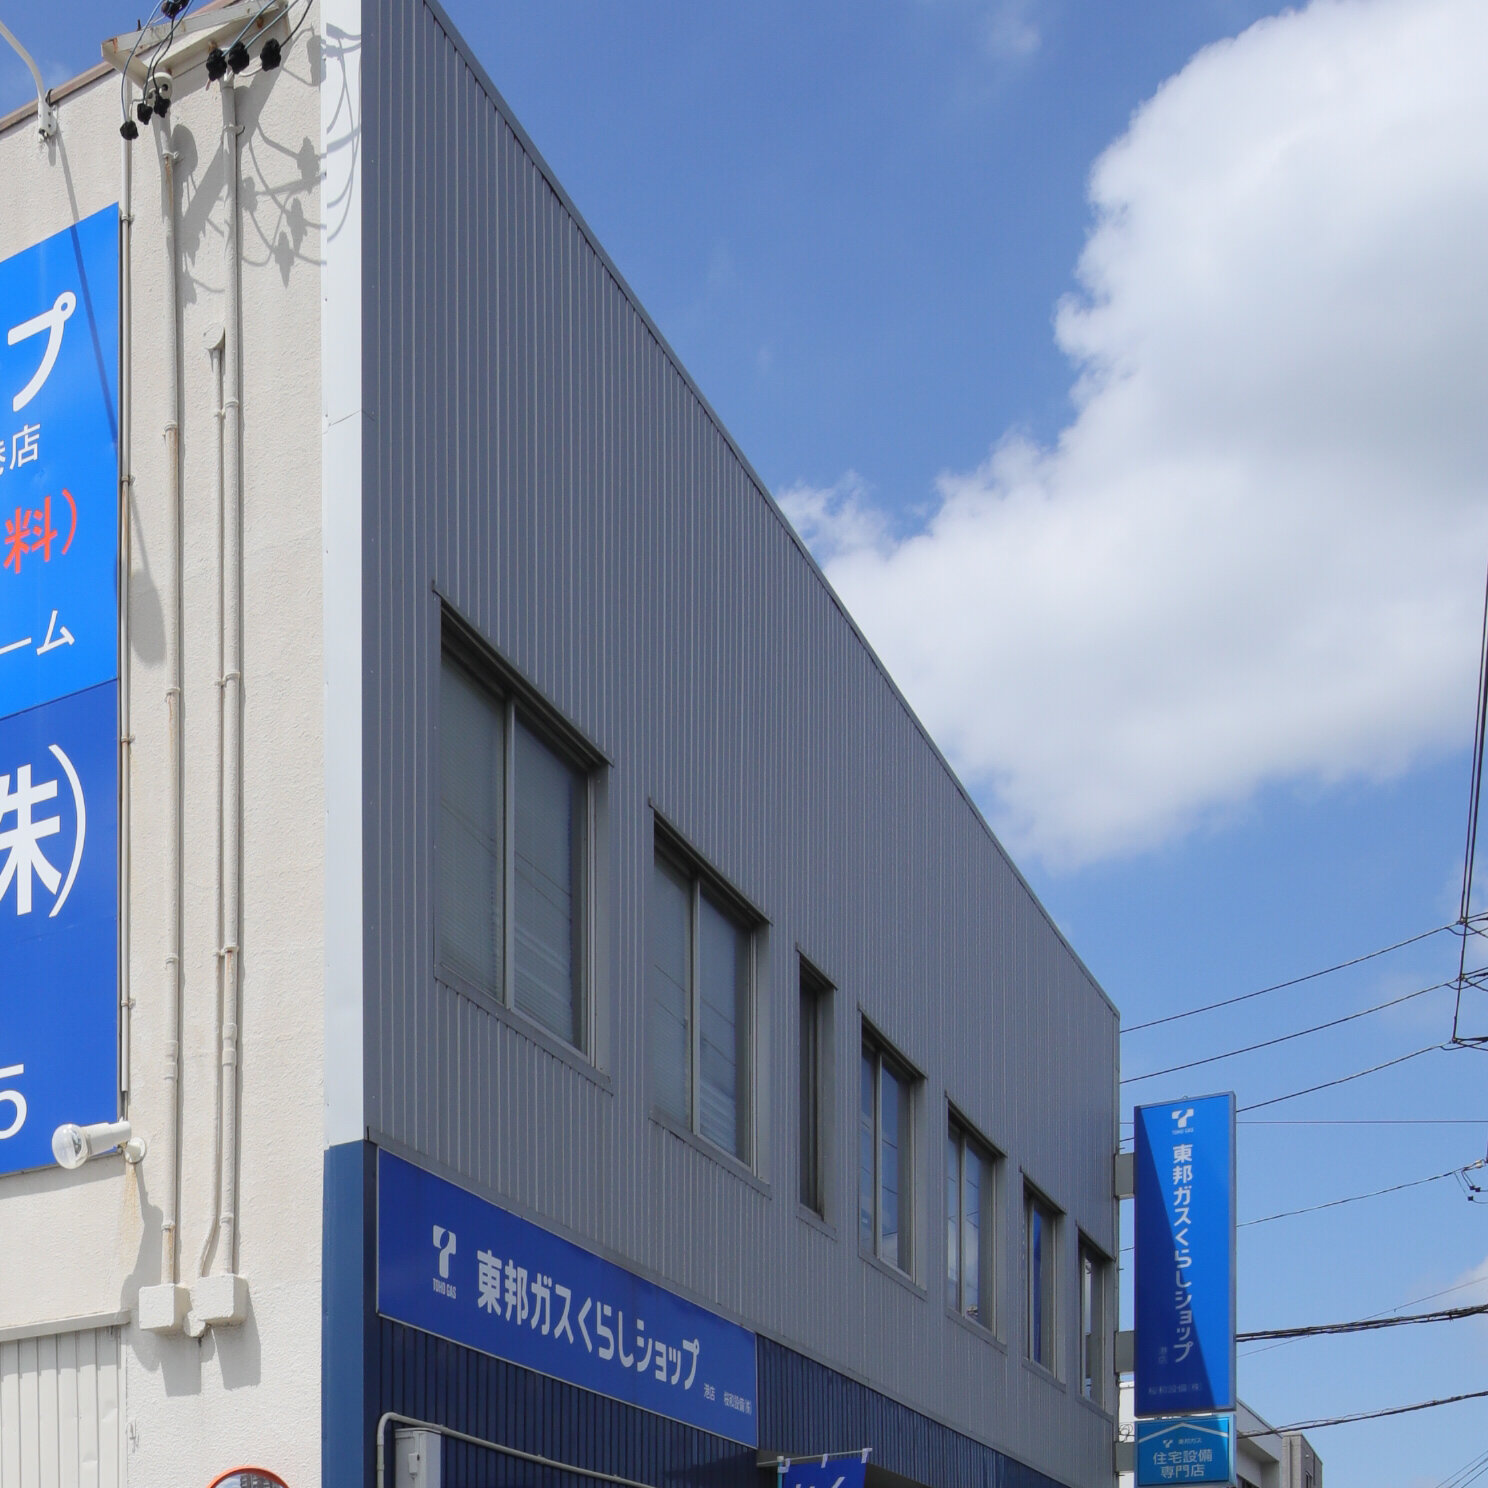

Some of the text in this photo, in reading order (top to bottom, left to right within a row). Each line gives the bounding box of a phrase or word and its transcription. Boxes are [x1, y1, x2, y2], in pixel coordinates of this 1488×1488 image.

[1173, 1144, 1194, 1364] 東邦ガスくらしショップ
[477, 1250, 700, 1390] 東邦ガスくらしショップ
[1153, 1449, 1213, 1465] 住宅設備
[1160, 1464, 1206, 1479] 専門店
